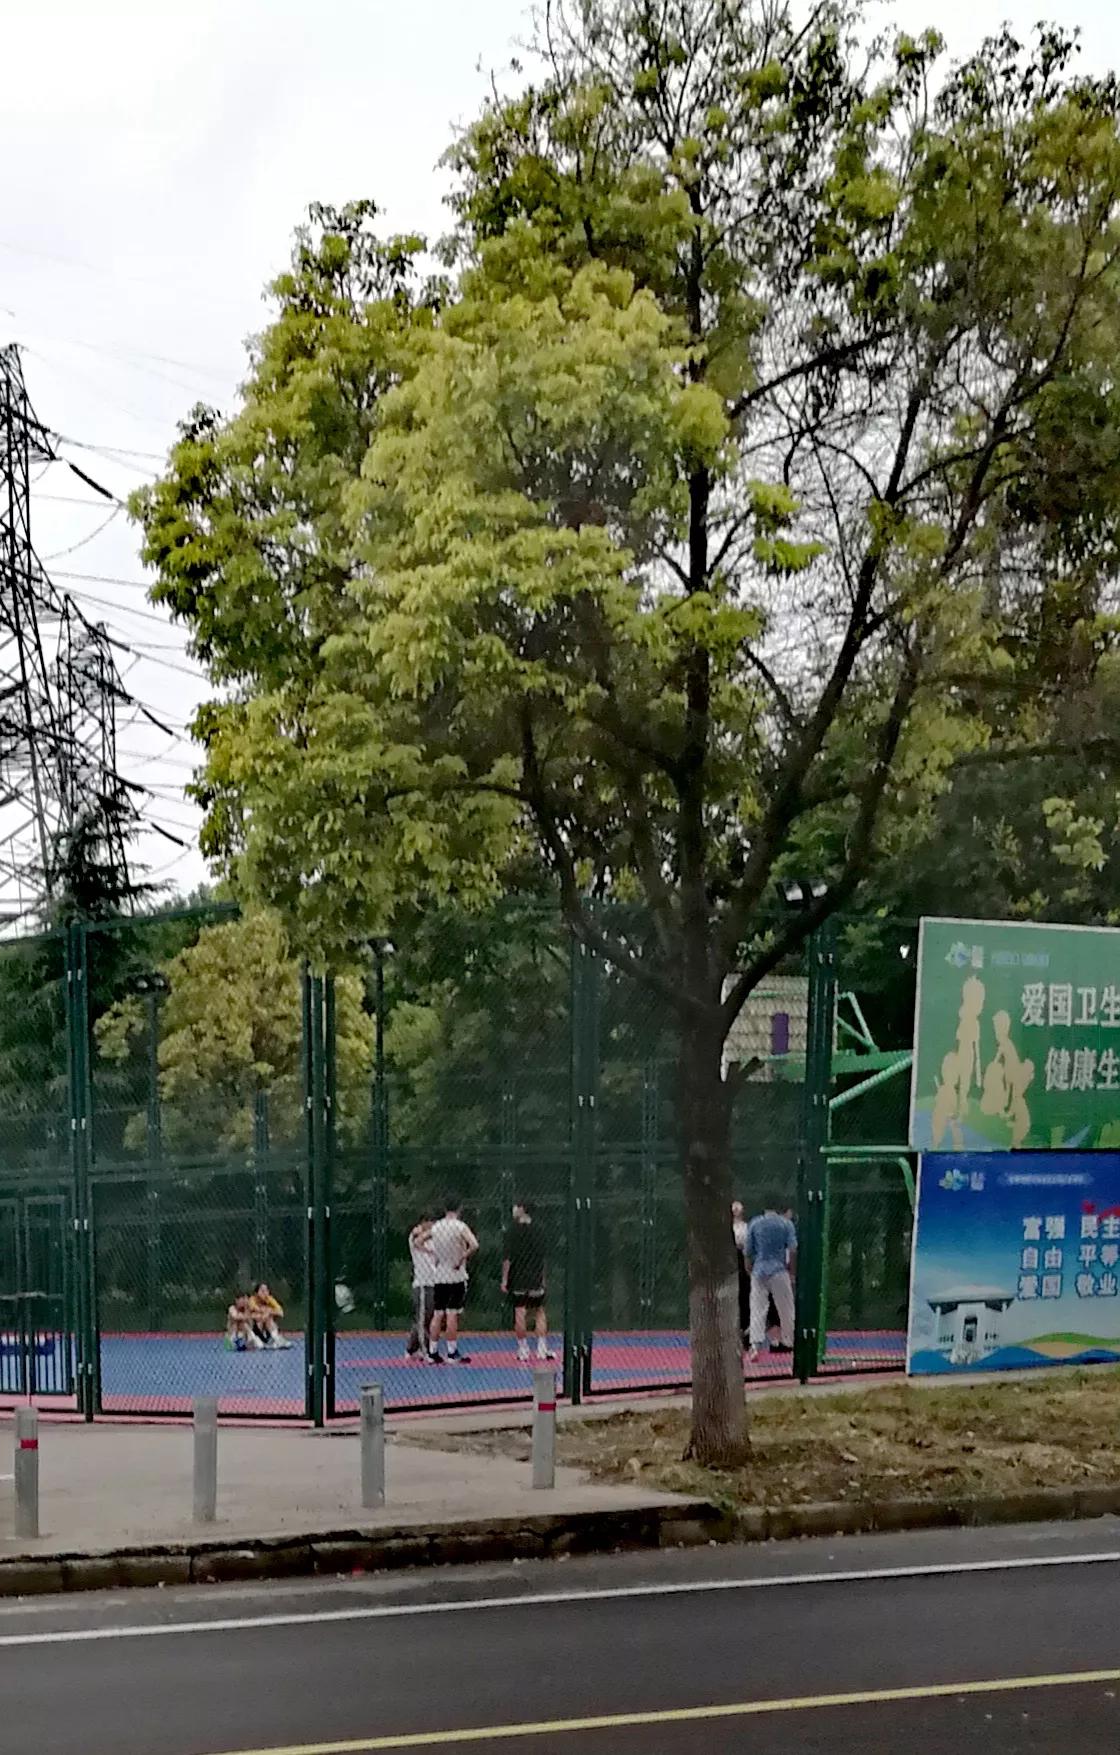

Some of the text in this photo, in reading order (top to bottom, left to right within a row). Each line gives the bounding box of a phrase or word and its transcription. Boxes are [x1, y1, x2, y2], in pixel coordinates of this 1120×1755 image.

[1023, 1215, 1120, 1240] 富强 民主
[1022, 1244, 1119, 1269] 自由 平等
[1019, 1273, 1116, 1298] 爱国 敬业
